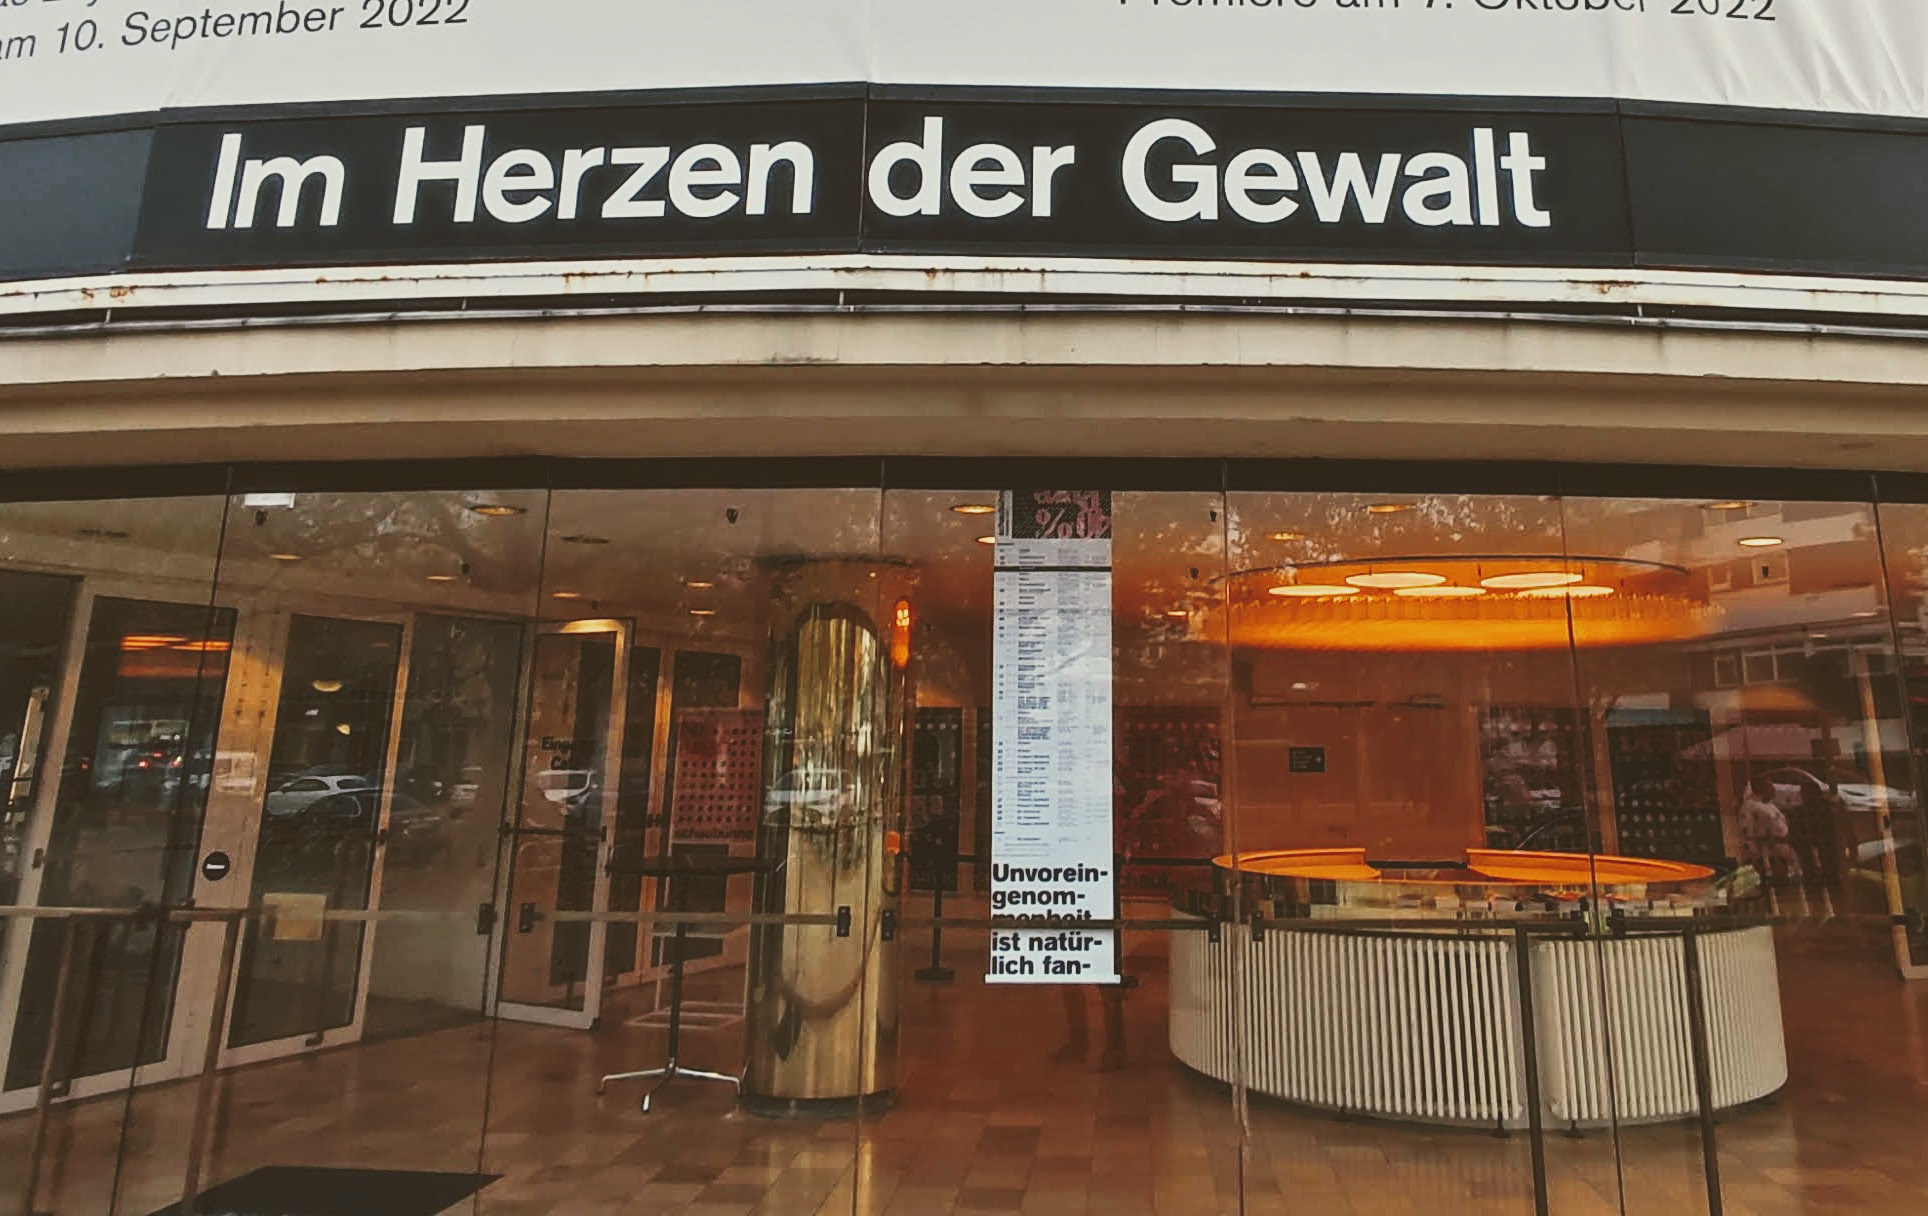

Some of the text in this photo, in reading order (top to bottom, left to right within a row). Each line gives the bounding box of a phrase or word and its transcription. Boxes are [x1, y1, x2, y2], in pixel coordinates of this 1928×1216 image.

[0, 0, 470, 60] m 10. September 2022
[205, 115, 1552, 229] Im Herzen der Gewalt
[992, 863, 1108, 882] Unvorein-
[992, 890, 1085, 909] genom-
[992, 931, 1102, 951] ist natür-
[992, 955, 1091, 975] lich fan-
